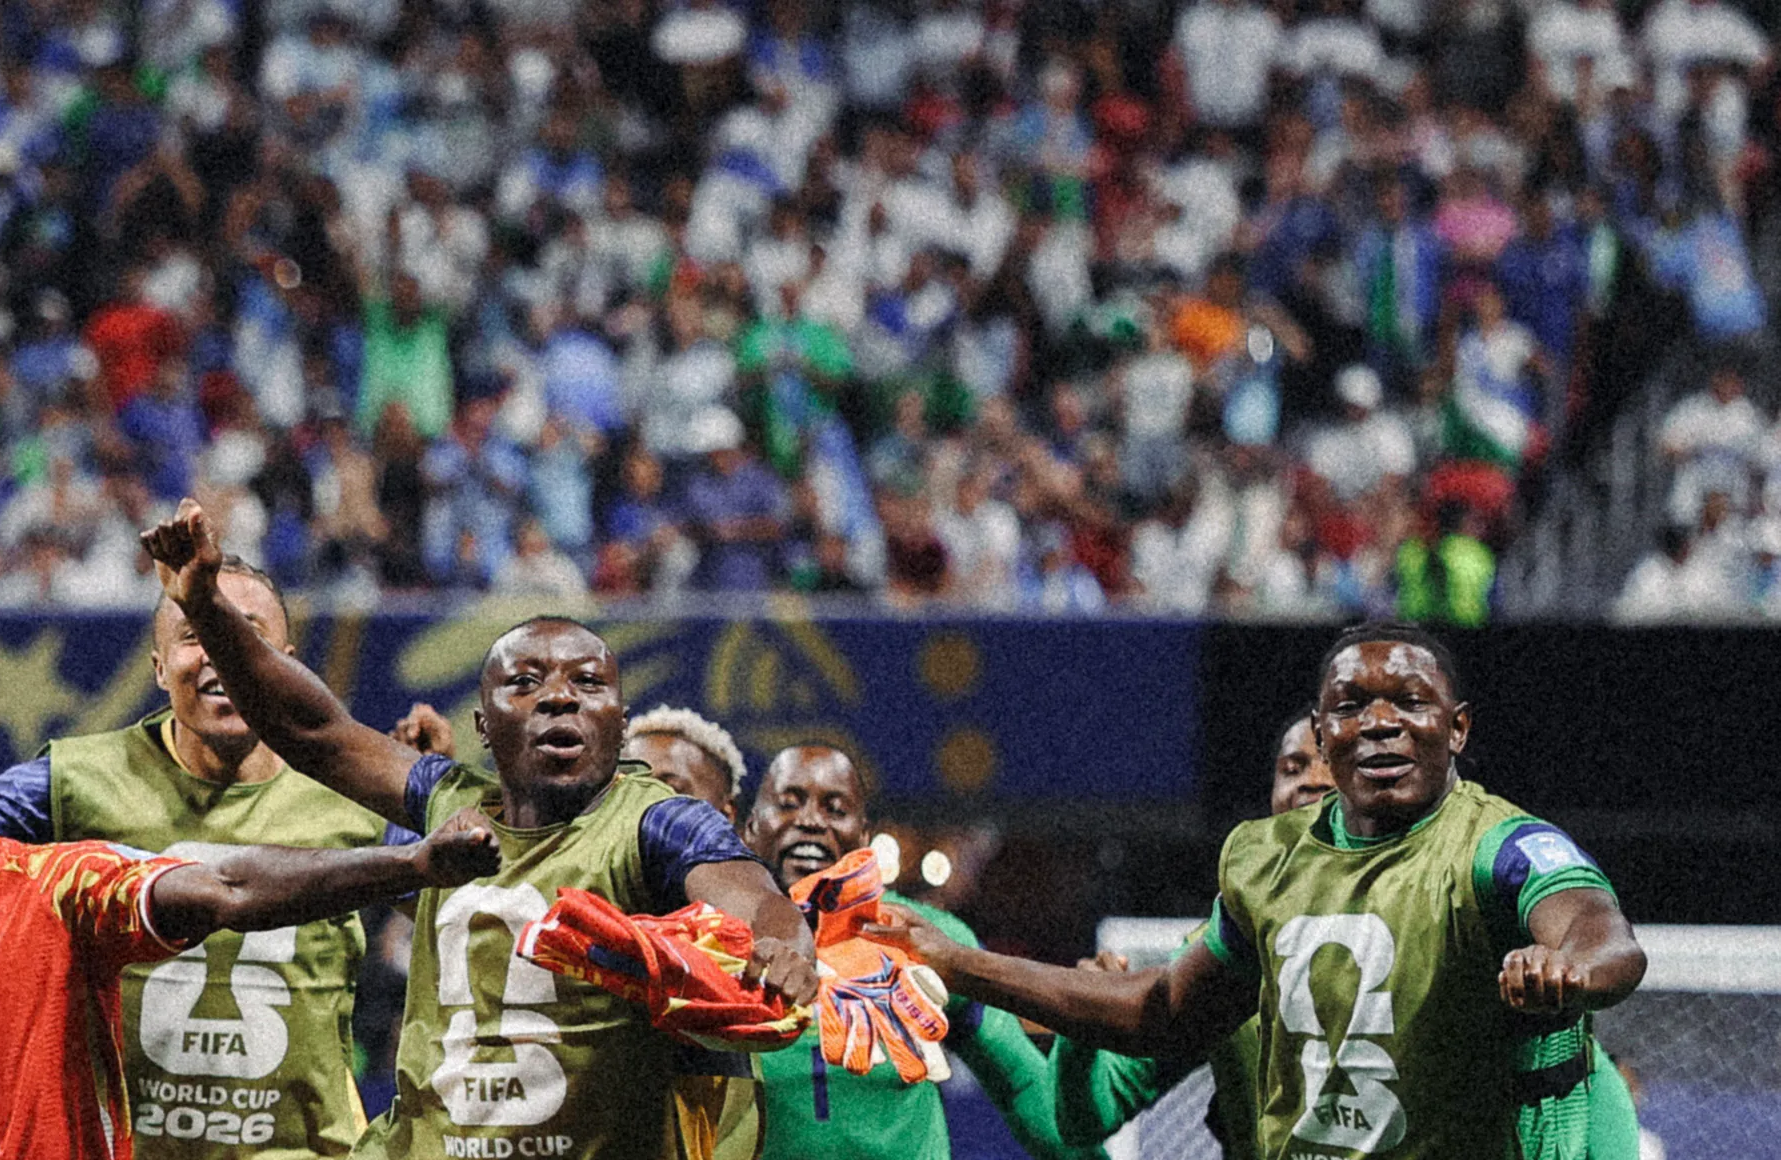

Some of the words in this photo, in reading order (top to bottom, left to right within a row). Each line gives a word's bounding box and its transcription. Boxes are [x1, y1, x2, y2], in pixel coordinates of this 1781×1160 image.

[182, 1031, 247, 1056] FIFA
[139, 1078, 227, 1105] WORLD
[232, 1088, 280, 1109] CUP
[464, 1077, 527, 1102] FIFA
[811, 1046, 830, 1121] 1
[135, 1104, 275, 1145] 2026
[1313, 1103, 1372, 1131] FIFA
[443, 1134, 513, 1159] WORLD
[518, 1135, 573, 1156] CUP
